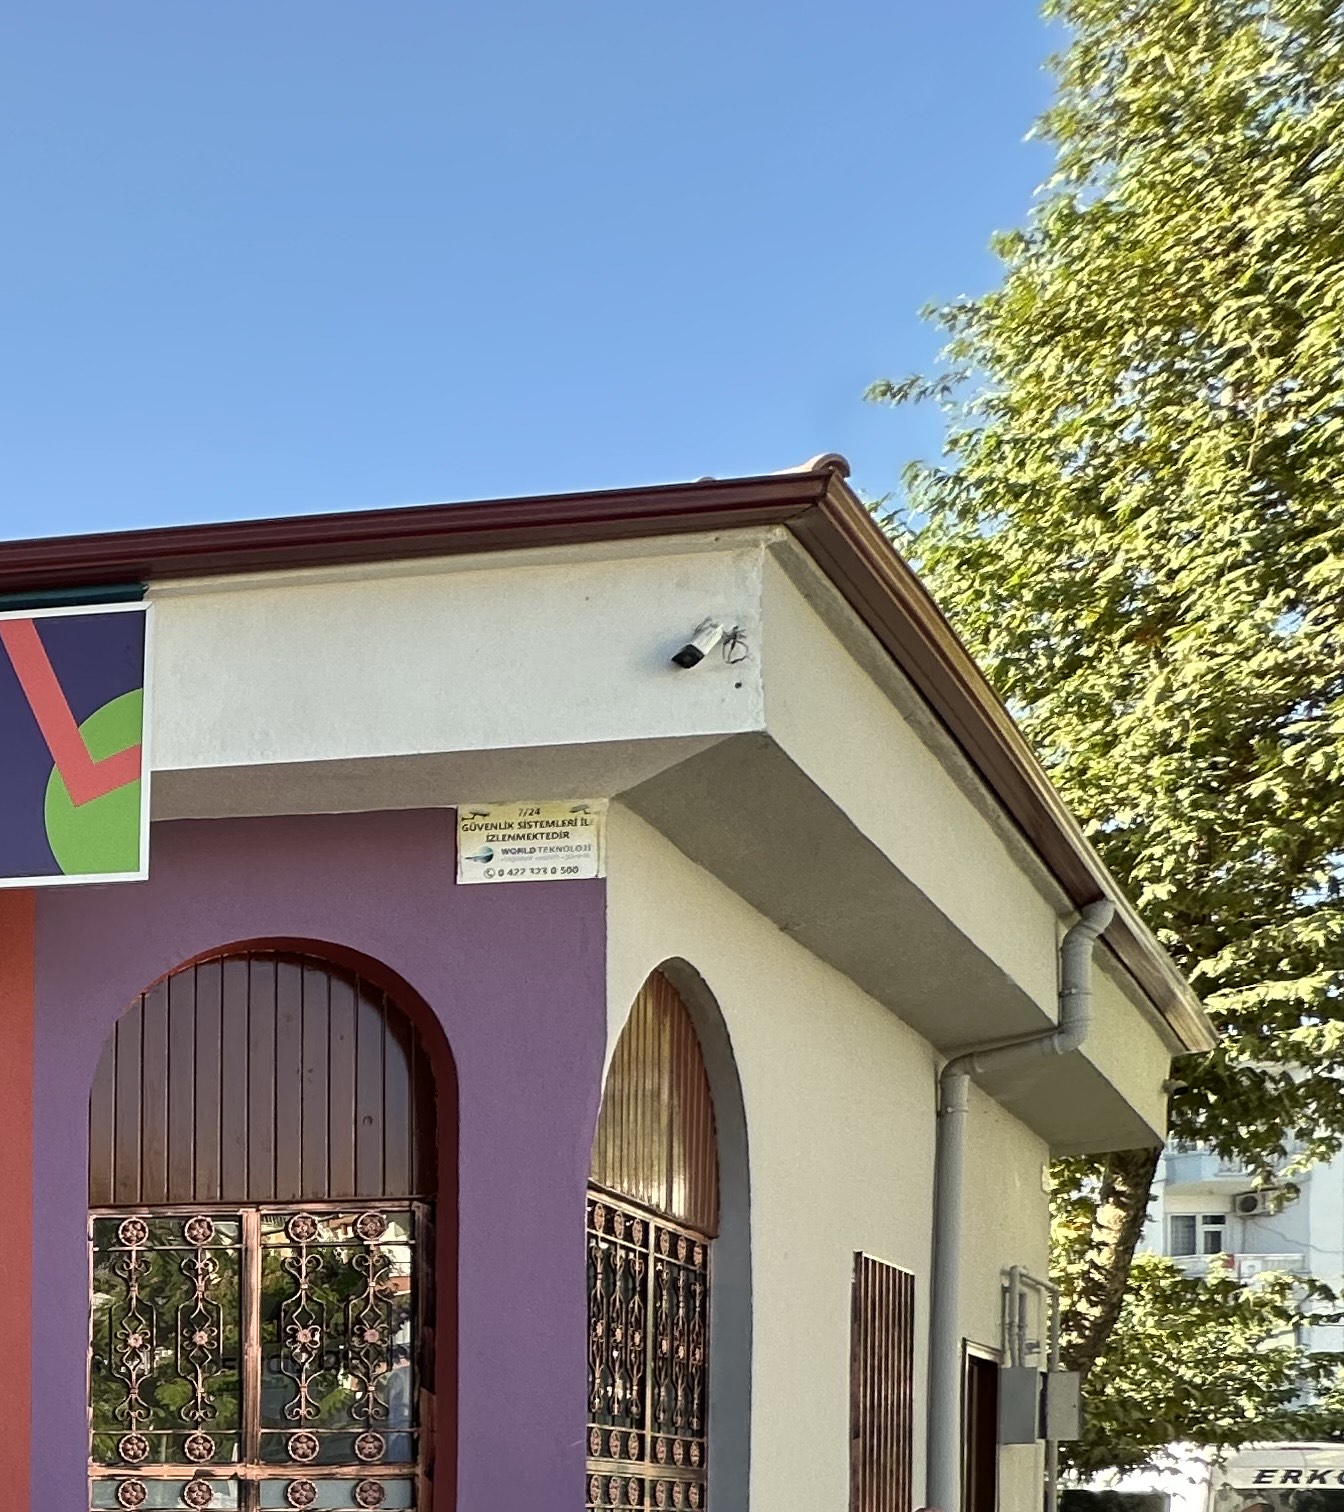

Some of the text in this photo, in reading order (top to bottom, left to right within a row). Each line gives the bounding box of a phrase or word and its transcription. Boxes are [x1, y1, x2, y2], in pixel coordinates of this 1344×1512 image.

[518, 808, 541, 817] 7/24
[461, 820, 515, 832] GÜVENLİK
[517, 816, 578, 830] SİSTEMLERİ
[485, 830, 570, 843] İZLENMEKTEDİR
[501, 847, 536, 855] WORLD
